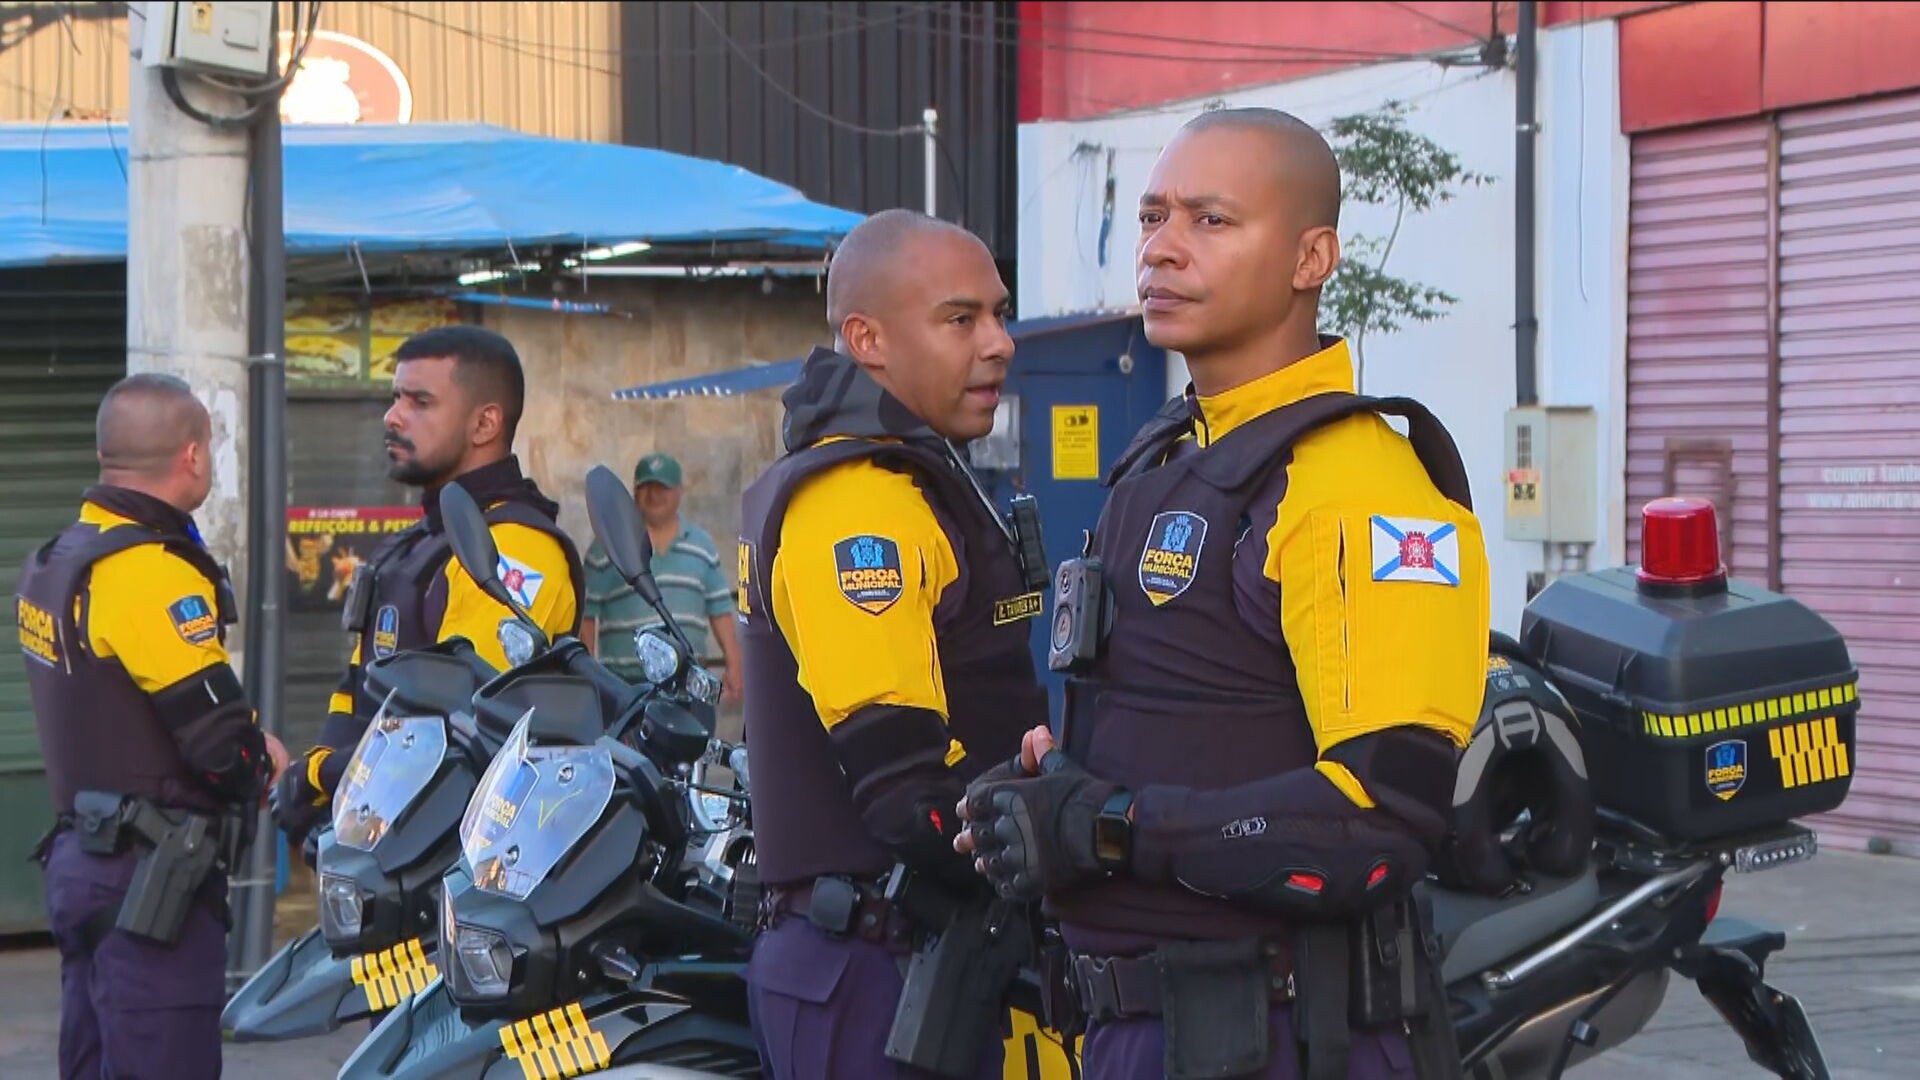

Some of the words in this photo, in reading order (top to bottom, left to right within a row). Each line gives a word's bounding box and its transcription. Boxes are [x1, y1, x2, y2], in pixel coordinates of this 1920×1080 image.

[288, 517, 365, 536] REFEIÇÕES
[1145, 549, 1193, 569] FORÇA
[840, 568, 900, 584] FORÇA
[1142, 562, 1192, 579] MUNICIPAL
[843, 580, 902, 591] MUNICIPAL
